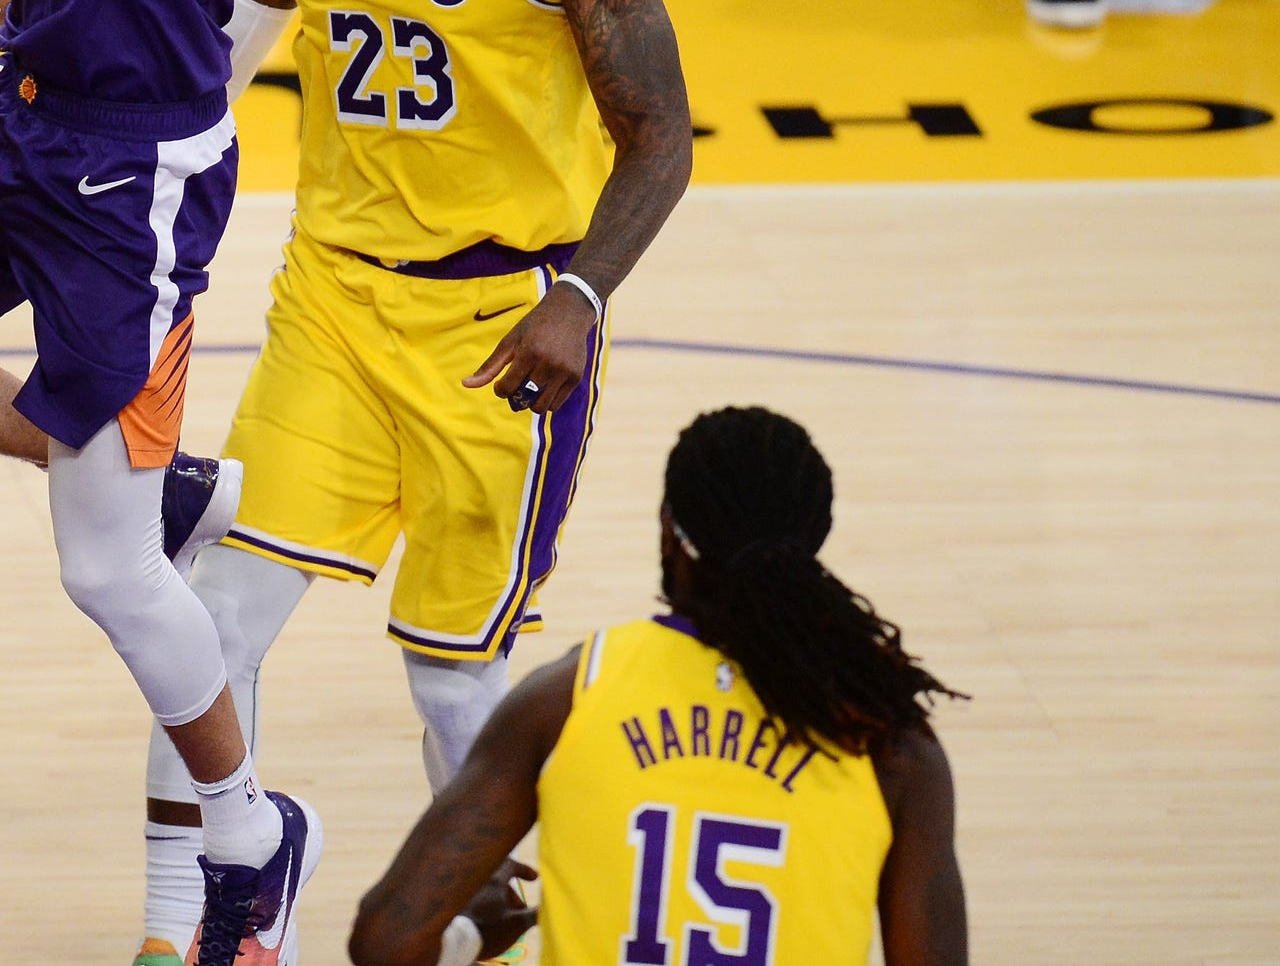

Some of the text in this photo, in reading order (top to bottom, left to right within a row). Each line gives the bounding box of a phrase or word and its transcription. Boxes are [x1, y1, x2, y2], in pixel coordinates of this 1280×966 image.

[329, 9, 457, 131] 23
[621, 705, 817, 793] HARRELL
[618, 802, 789, 966] 15
